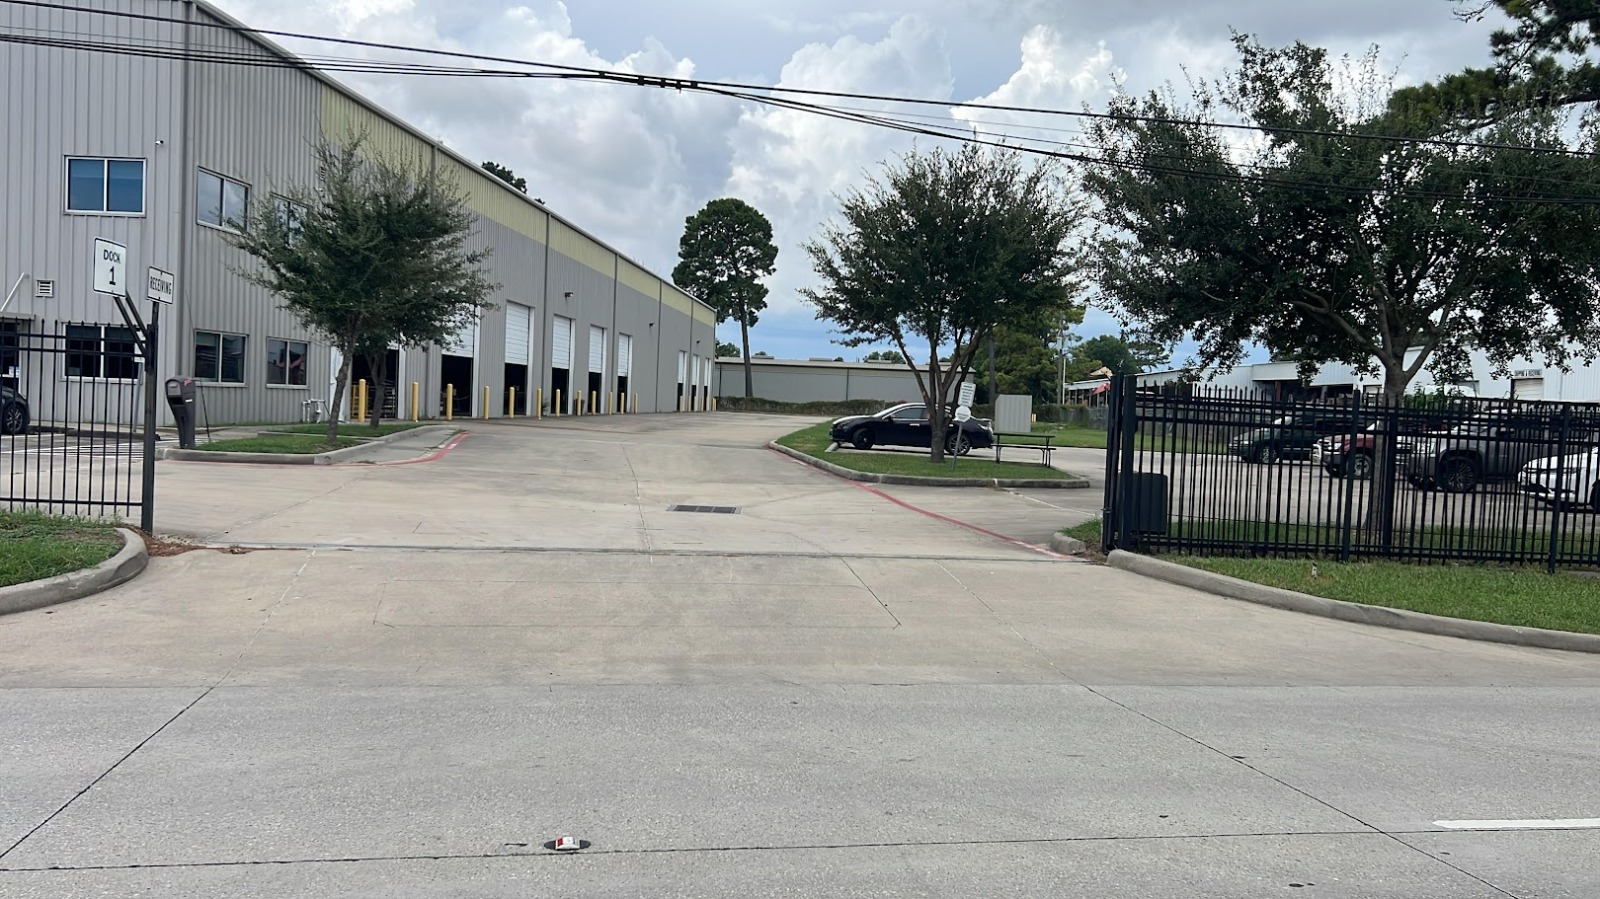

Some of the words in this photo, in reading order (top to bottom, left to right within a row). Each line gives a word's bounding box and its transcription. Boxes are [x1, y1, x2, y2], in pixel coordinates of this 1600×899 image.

[103, 249, 121, 264] DOCK
[109, 266, 116, 285] 1
[149, 276, 172, 294] RECEIVING
